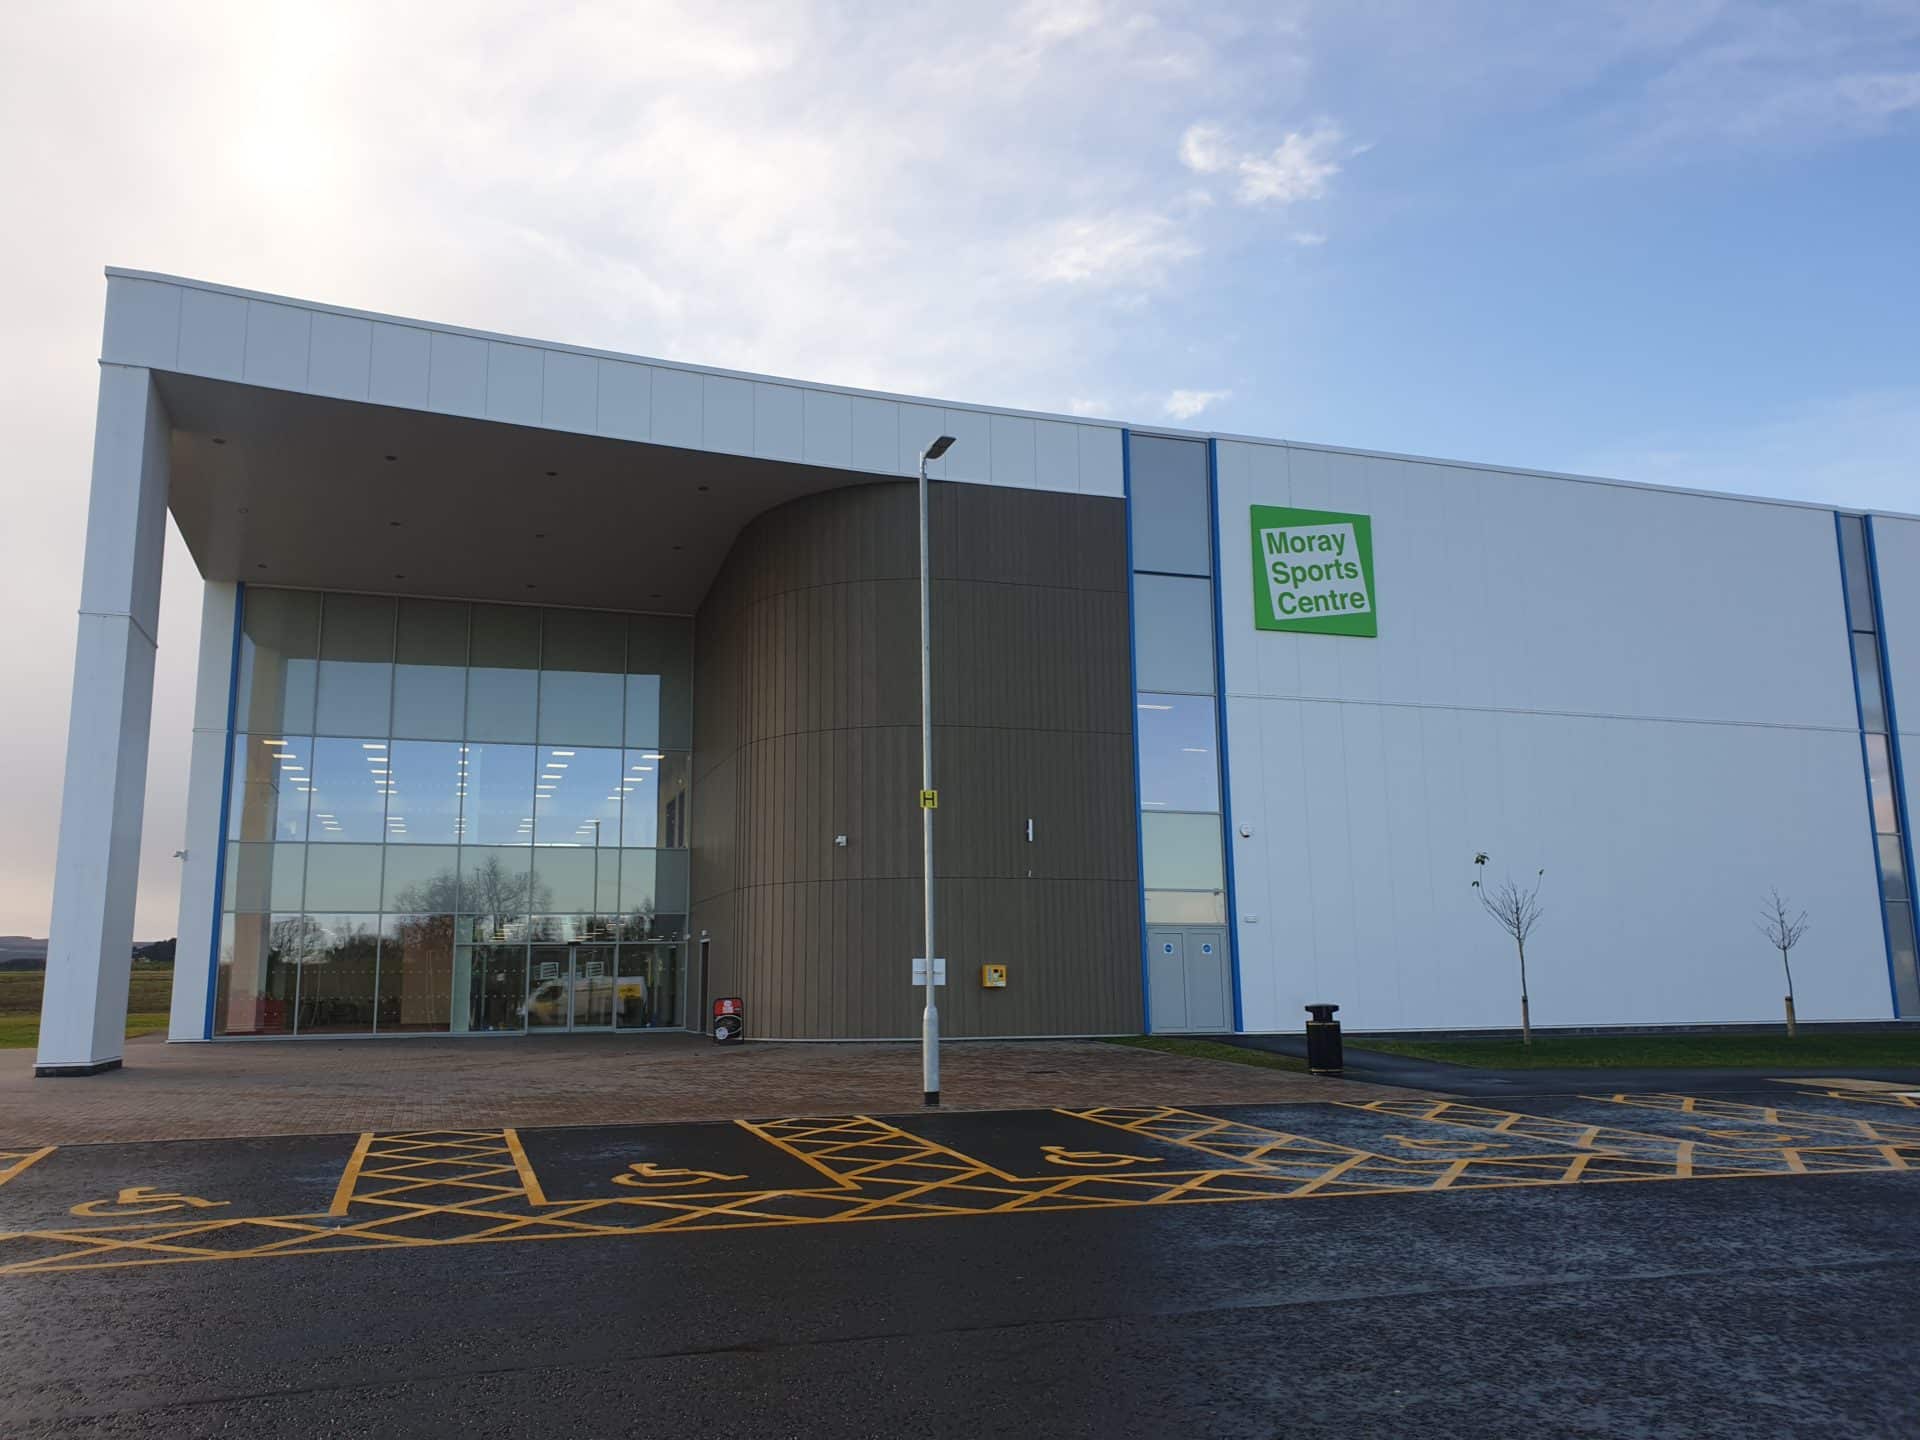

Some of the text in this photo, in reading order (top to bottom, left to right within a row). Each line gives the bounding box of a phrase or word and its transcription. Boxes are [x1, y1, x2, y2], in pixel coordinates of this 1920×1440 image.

[1266, 532, 1345, 556] Moray
[1271, 559, 1358, 589] Sports
[1278, 590, 1365, 615] Centre
[922, 791, 935, 806] H
